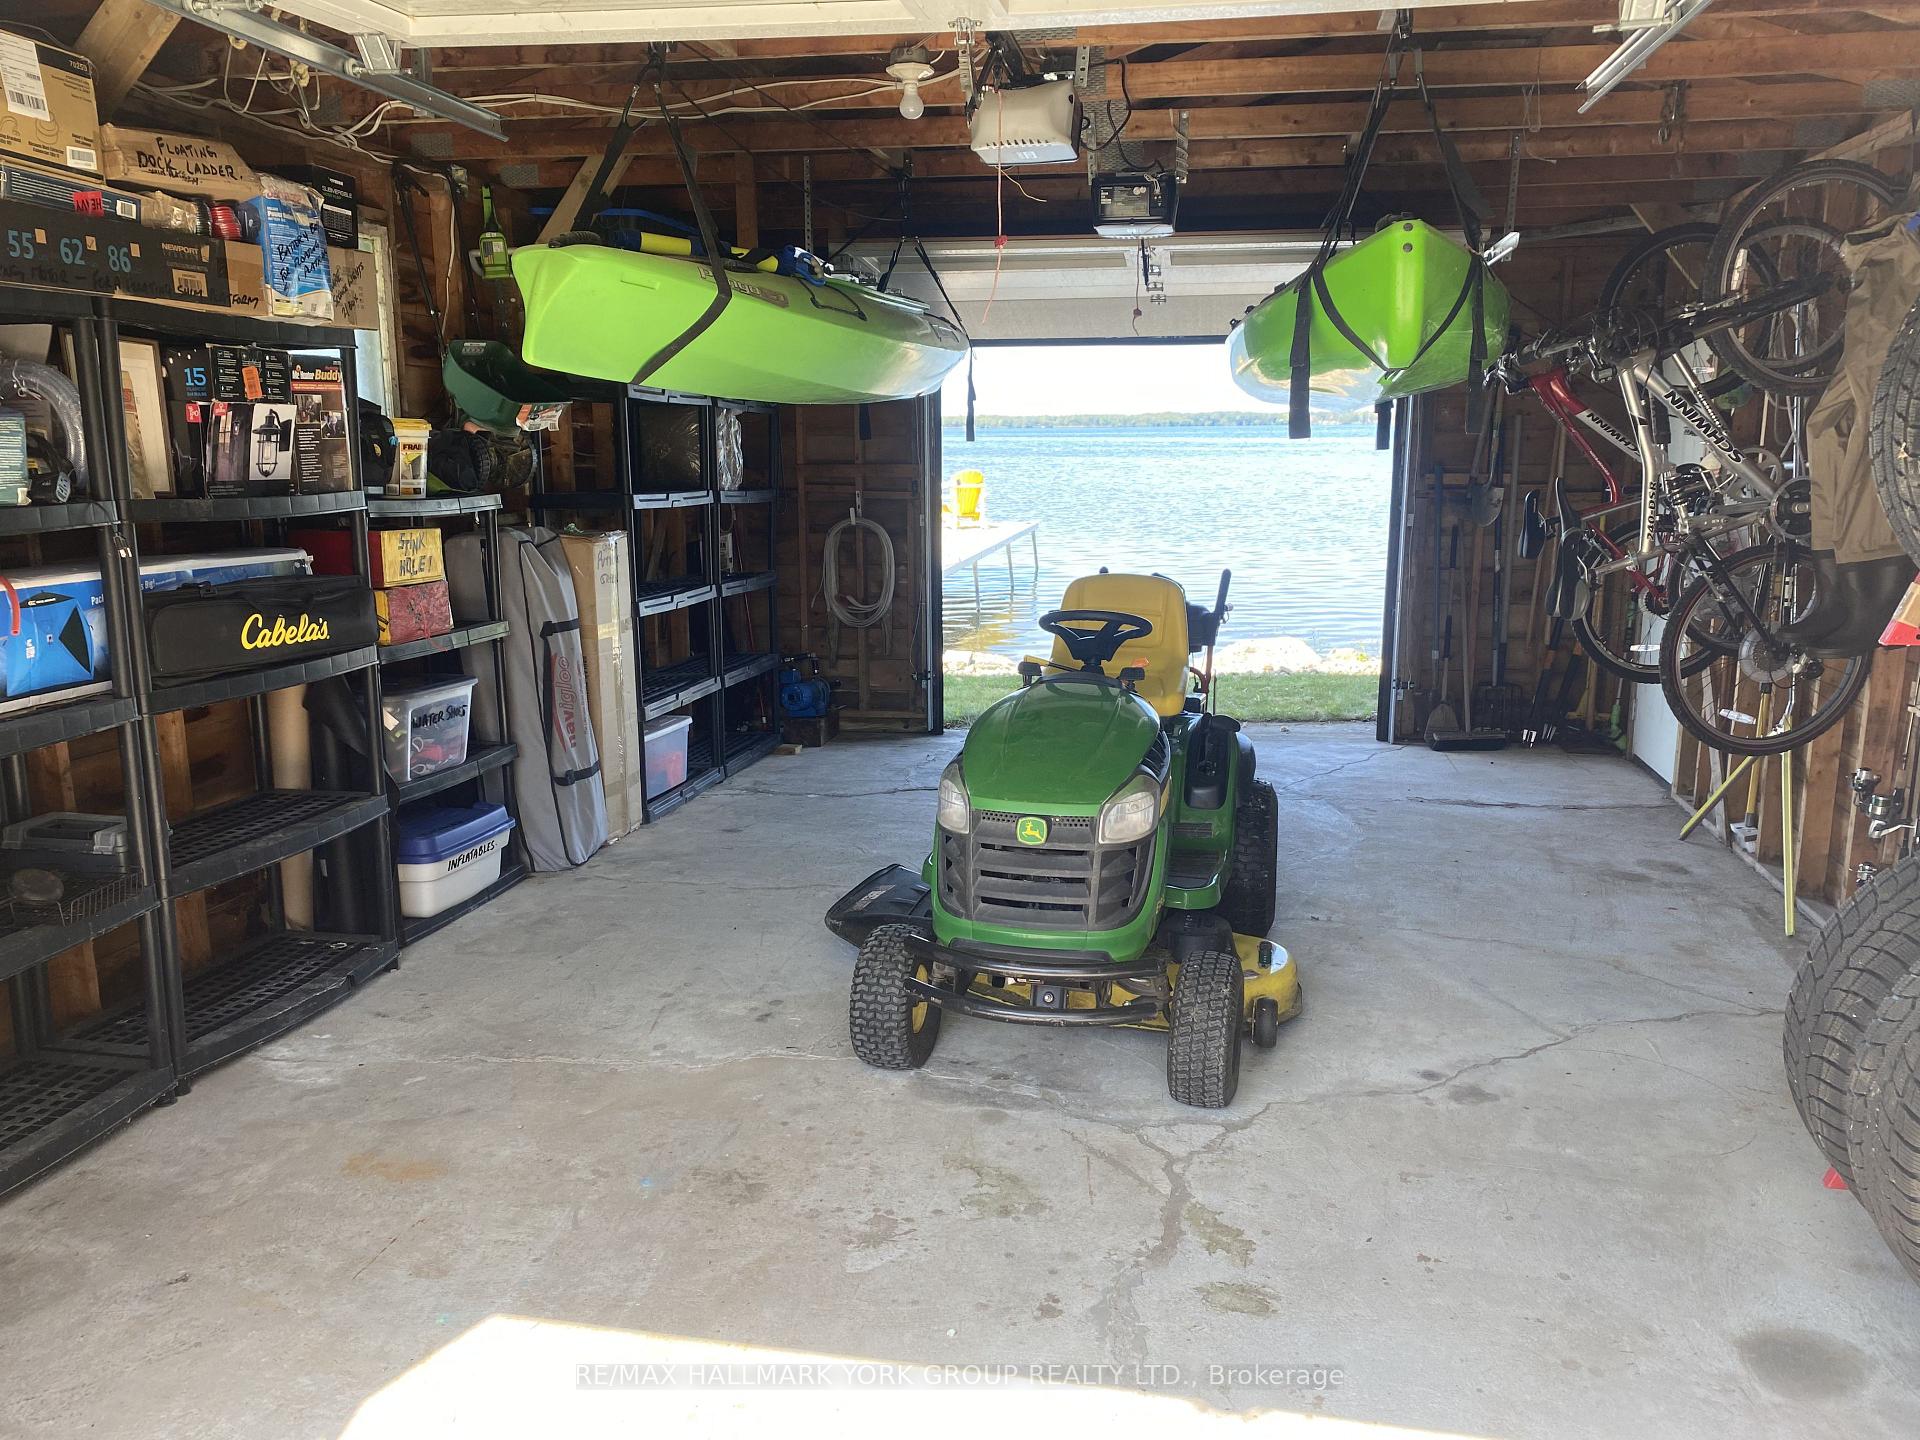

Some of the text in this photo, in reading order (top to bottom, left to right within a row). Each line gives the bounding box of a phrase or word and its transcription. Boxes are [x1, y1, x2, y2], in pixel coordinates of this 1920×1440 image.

[156, 136, 217, 159] FLOATING
[136, 150, 177, 172] DOCK
[8, 229, 34, 259] 55
[60, 237, 86, 265] 62
[161, 242, 200, 255] NEWPORT
[107, 245, 131, 273] 86
[184, 367, 206, 386] 15
[315, 369, 341, 383] Buddy
[1664, 389, 1746, 463] SCHWINN
[91, 594, 104, 606] Pac
[241, 613, 329, 650] Cabela's
[553, 656, 578, 748] navigloo
[412, 711, 445, 728] WATER
[448, 840, 495, 871] INFLATABLES
